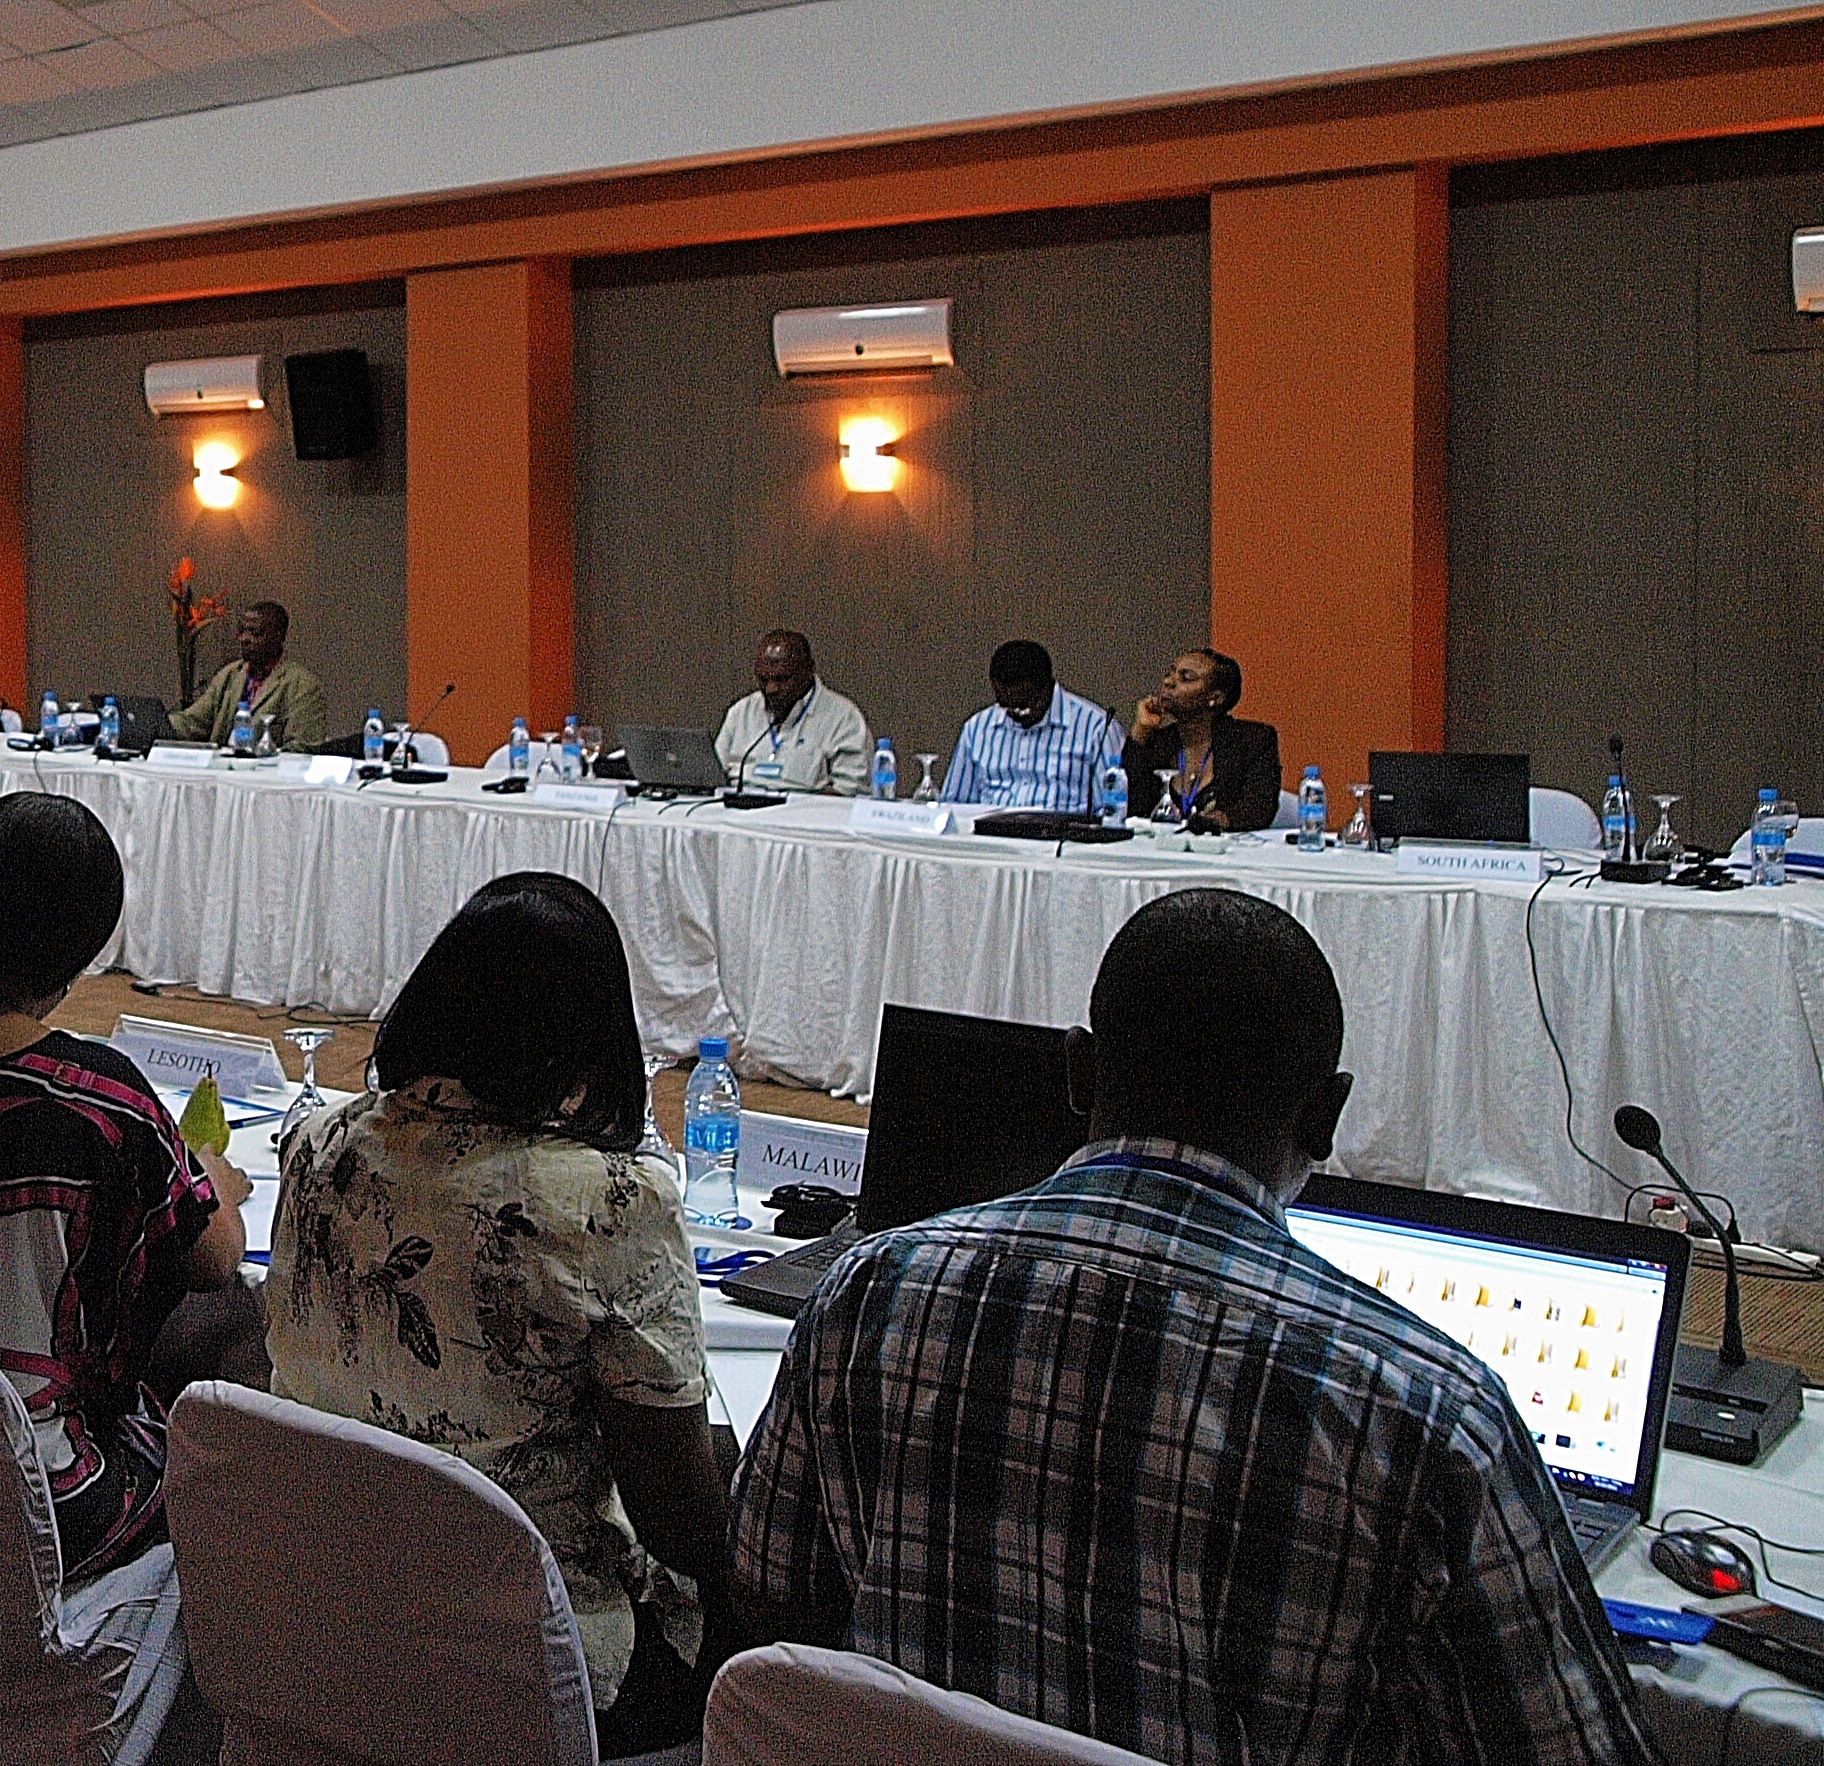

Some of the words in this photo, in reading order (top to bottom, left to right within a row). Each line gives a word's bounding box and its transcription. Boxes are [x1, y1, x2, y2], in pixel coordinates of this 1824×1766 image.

[1417, 855, 1467, 869] SOUTH
[1471, 857, 1527, 872] AFRICA
[147, 1048, 222, 1075] LESOTHO
[761, 1144, 862, 1182] MALAWI
